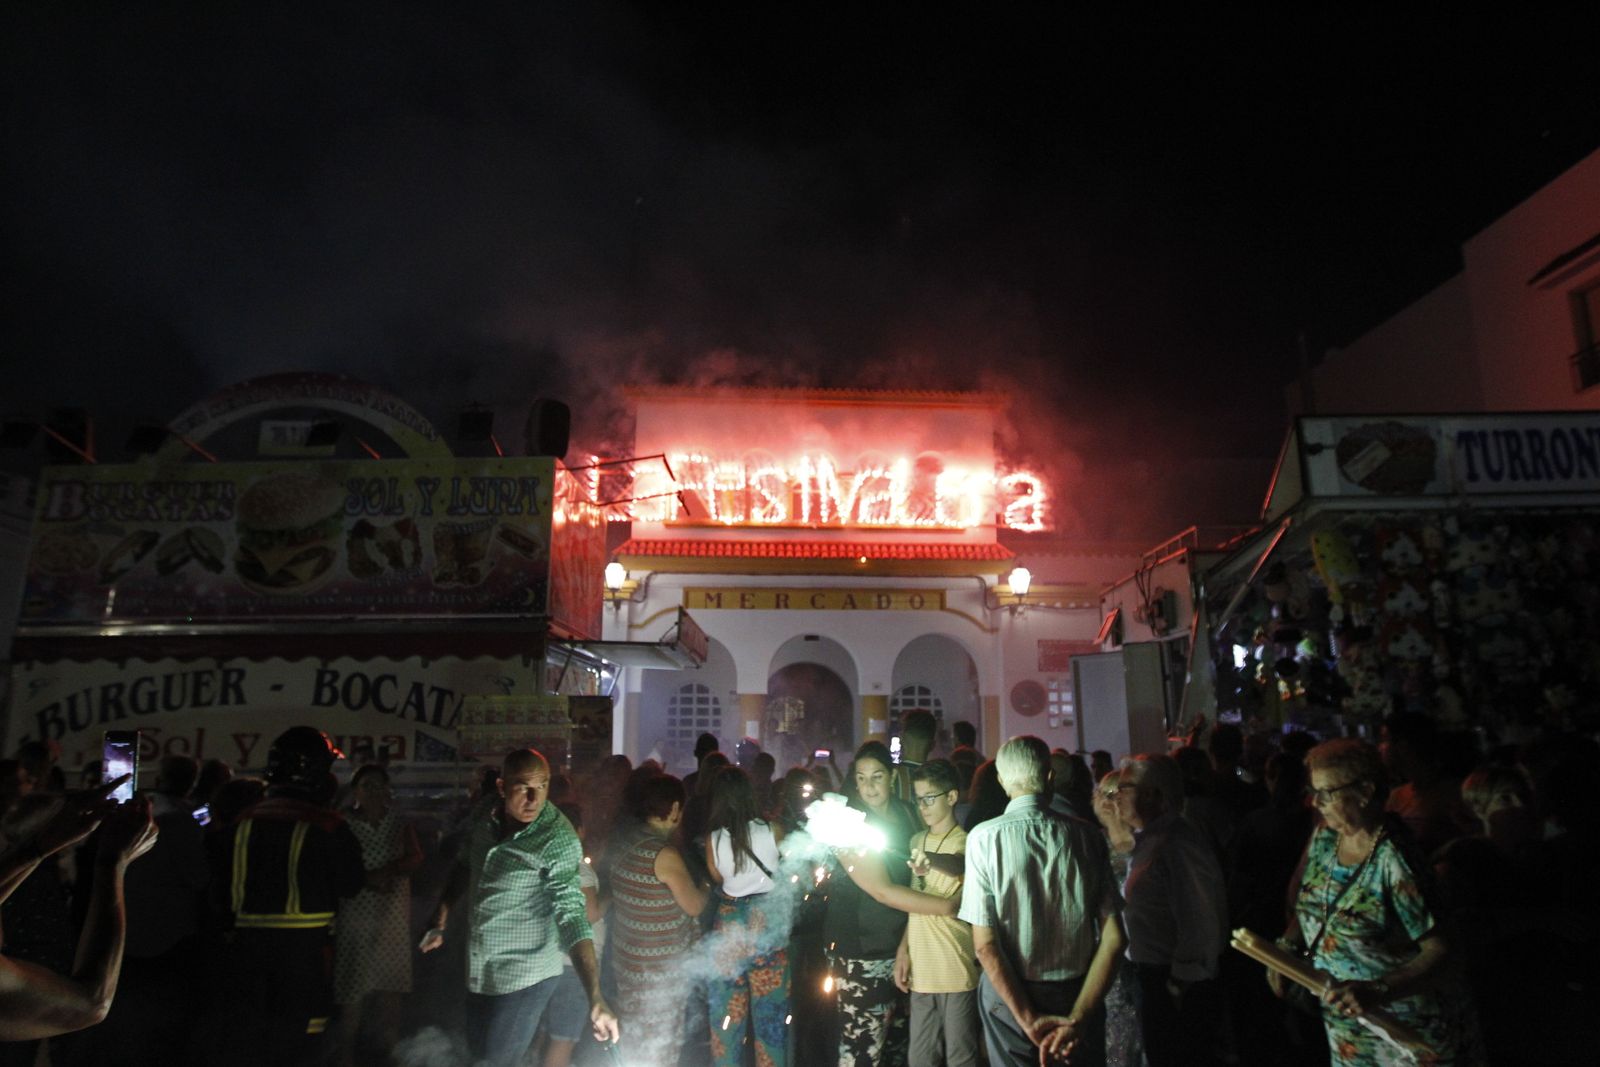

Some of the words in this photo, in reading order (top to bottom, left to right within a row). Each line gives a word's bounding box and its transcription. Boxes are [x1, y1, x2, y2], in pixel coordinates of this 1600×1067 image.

[345, 476, 404, 516] SOL
[415, 476, 440, 516] Y
[447, 475, 540, 516] LUNA
[704, 592, 925, 610] MERCADO
[35, 668, 248, 743] BURGUER
[137, 727, 206, 762] Sol
